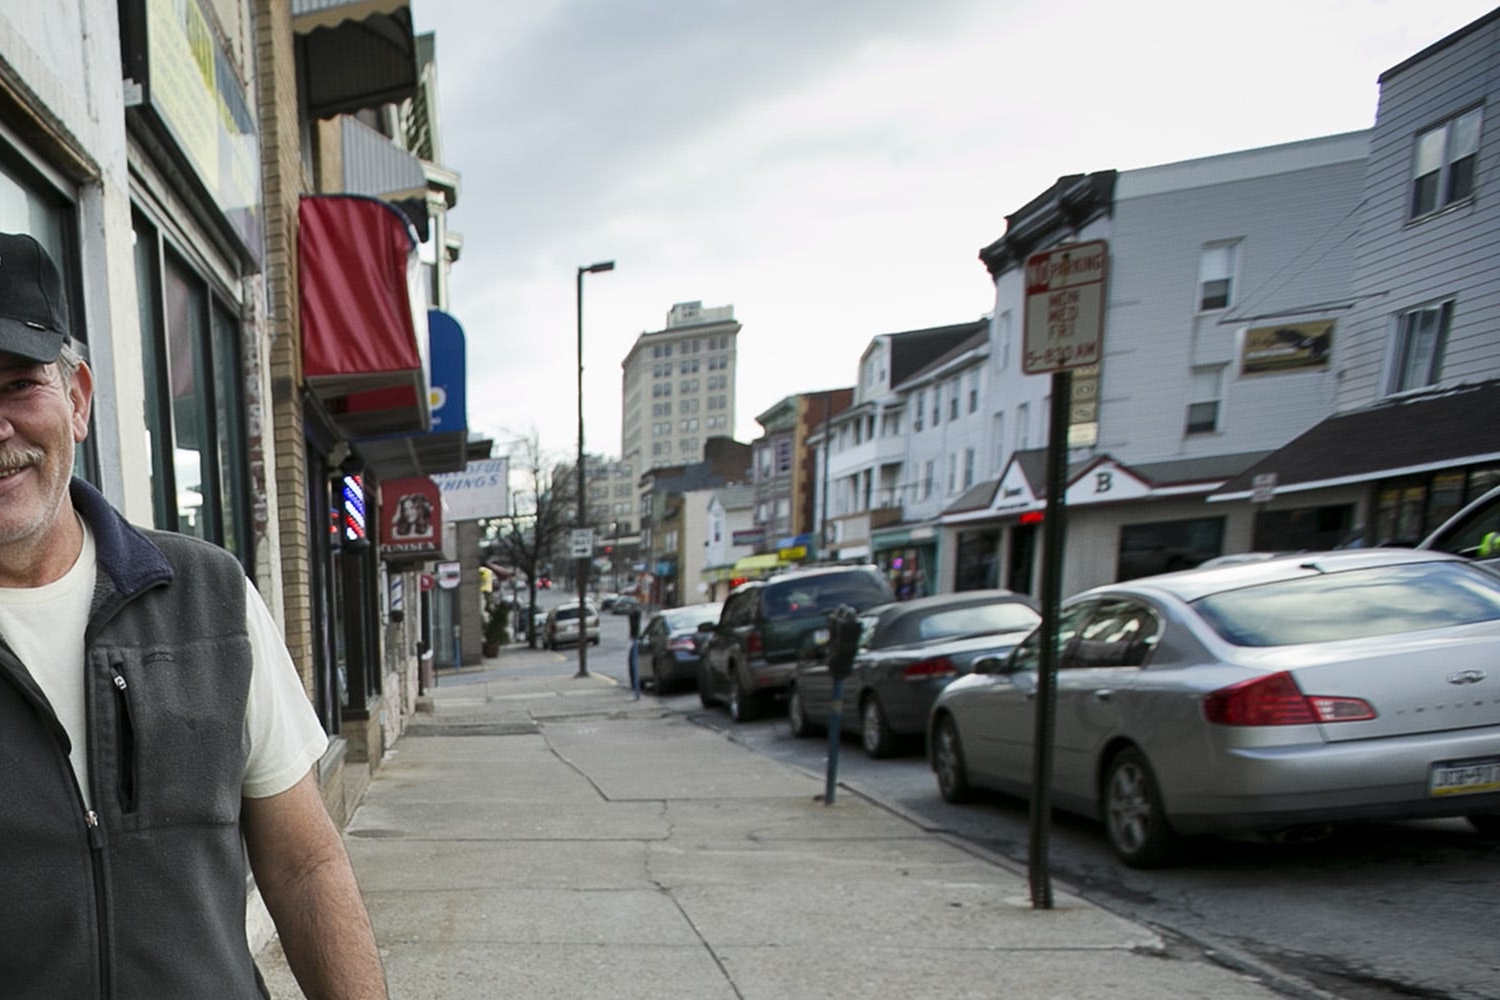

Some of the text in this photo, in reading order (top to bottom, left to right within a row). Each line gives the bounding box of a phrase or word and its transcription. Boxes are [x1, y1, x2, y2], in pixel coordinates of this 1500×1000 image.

[1050, 255, 1104, 275] PARKING
[1048, 290, 1079, 307] MON
[1047, 322, 1076, 340] FRI
[1075, 342, 1097, 358] AM
[1095, 471, 1112, 494] B
